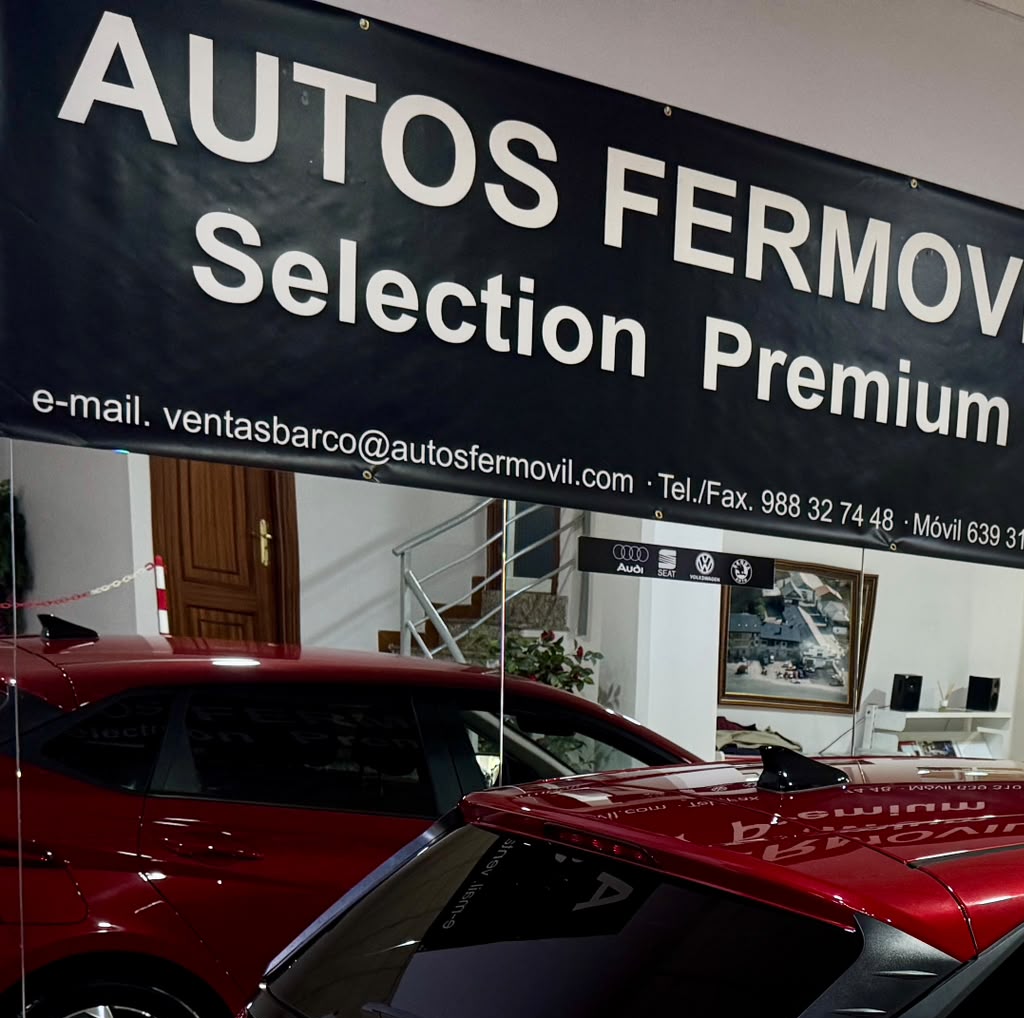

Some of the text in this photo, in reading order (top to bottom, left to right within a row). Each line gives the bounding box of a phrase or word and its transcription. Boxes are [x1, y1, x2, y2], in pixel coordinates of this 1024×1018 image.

[58, 10, 559, 229] AUTOS
[191, 211, 1010, 447] Selection Premium
[31, 388, 150, 427] e-mail.
[161, 406, 635, 495] ventasbarco@autosfermovil.com
[657, 472, 753, 512] Tel./Fax.
[761, 488, 802, 518] 988
[807, 495, 834, 523] 32
[840, 500, 865, 528] 74
[869, 505, 895, 533] 48
[912, 511, 963, 542] Móvil
[966, 520, 1002, 547] 639
[616, 562, 644, 574] Audi
[657, 567, 677, 579] SEAT
